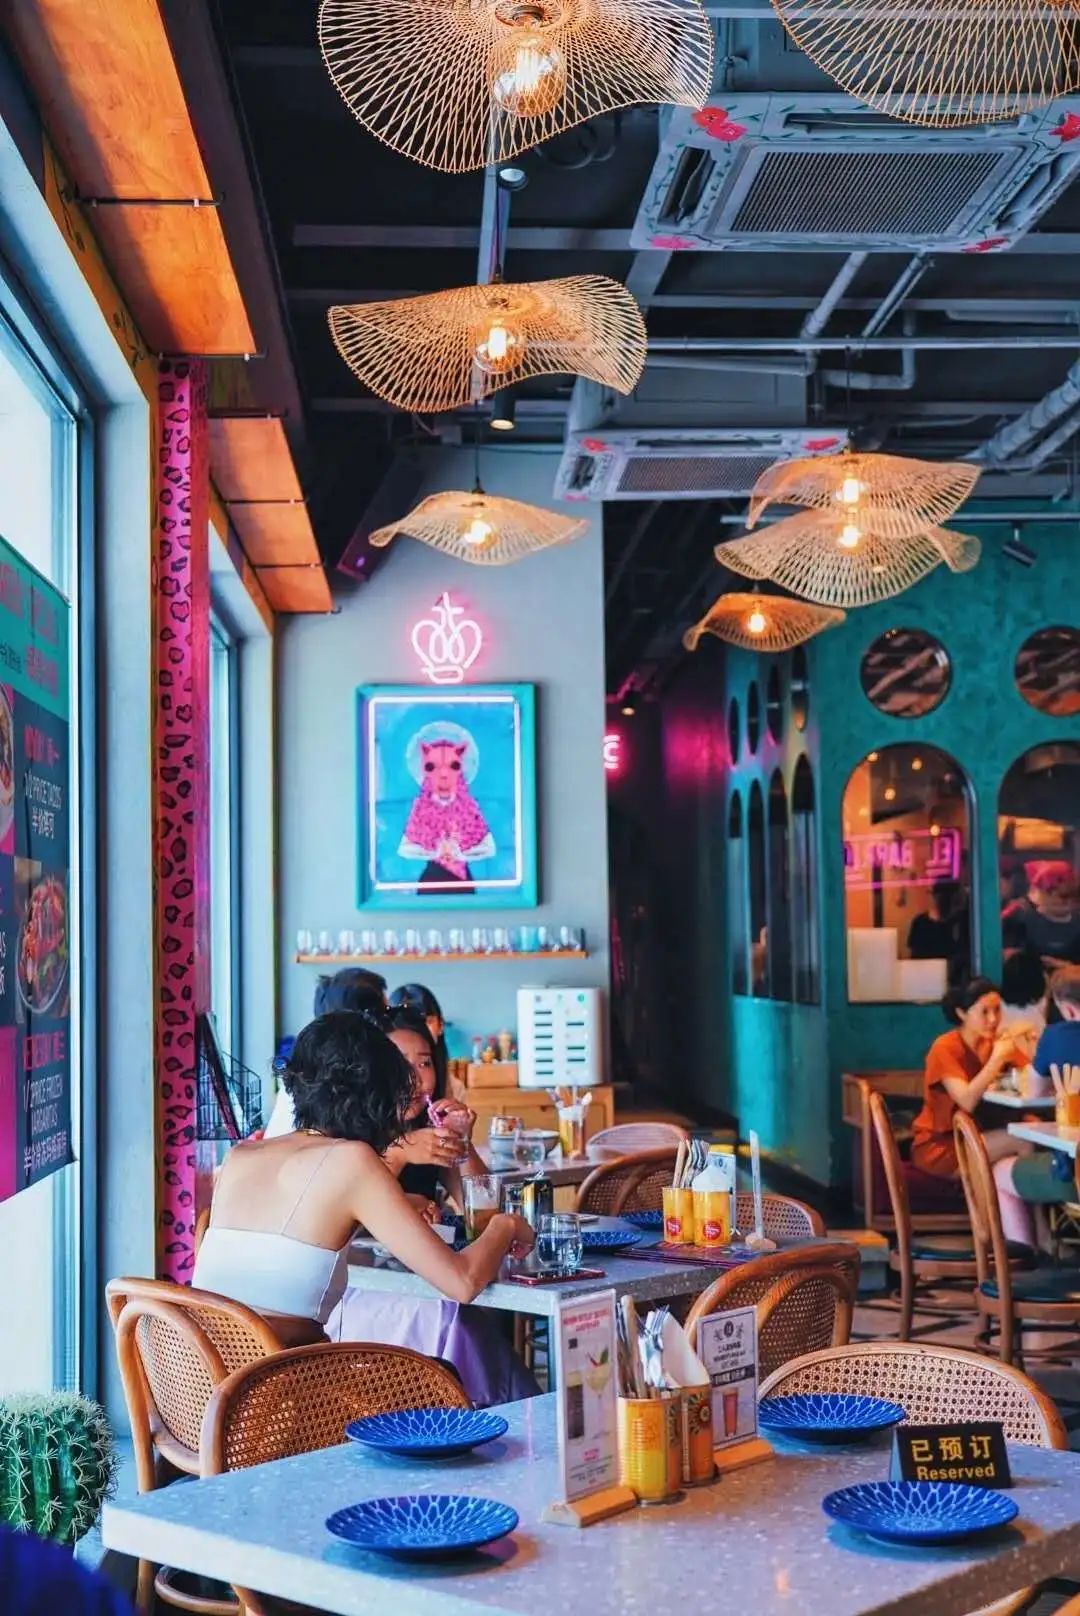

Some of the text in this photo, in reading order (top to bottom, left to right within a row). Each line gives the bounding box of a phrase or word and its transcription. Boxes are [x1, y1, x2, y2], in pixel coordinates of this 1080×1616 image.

[910, 1435, 992, 1462] 已预订
[916, 1462, 996, 1481] Reserved
